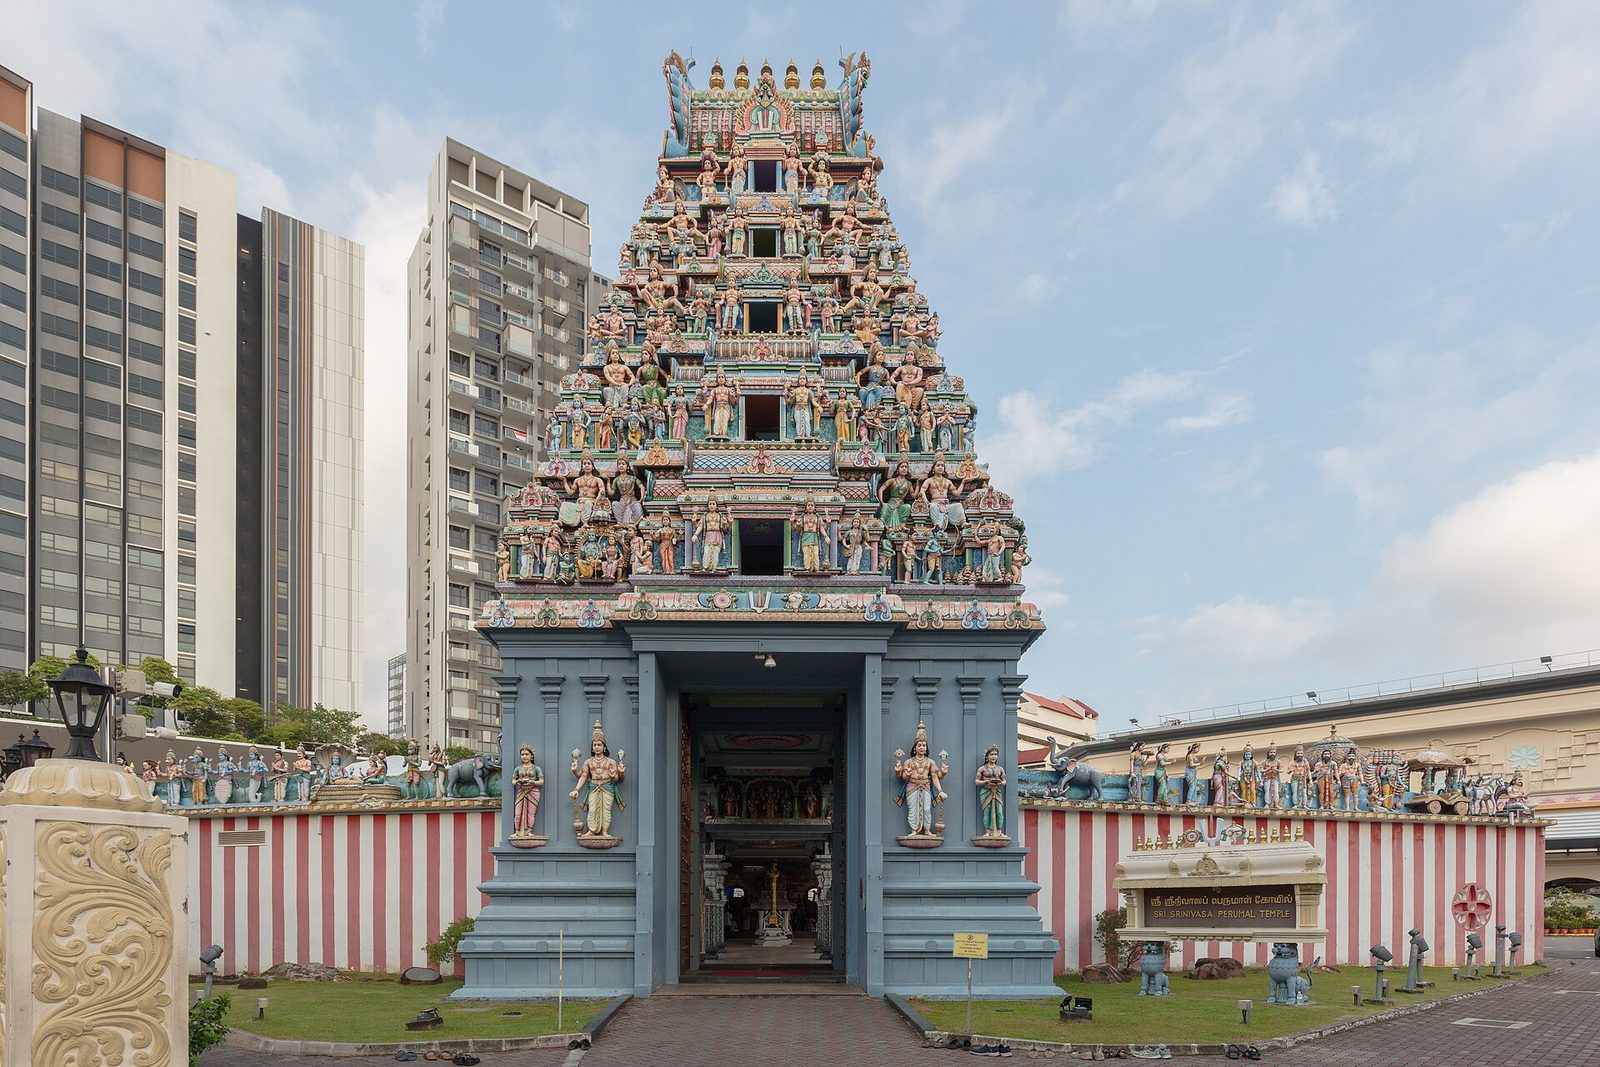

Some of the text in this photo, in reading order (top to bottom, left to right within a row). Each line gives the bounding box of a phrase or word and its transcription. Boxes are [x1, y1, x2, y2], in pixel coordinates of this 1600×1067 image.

[1211, 896, 1252, 905] பெருமாள்
[1255, 894, 1293, 904] கோயில்
[1153, 910, 1290, 918] SRI SRINIVASA PERUMAL TEMPLE
